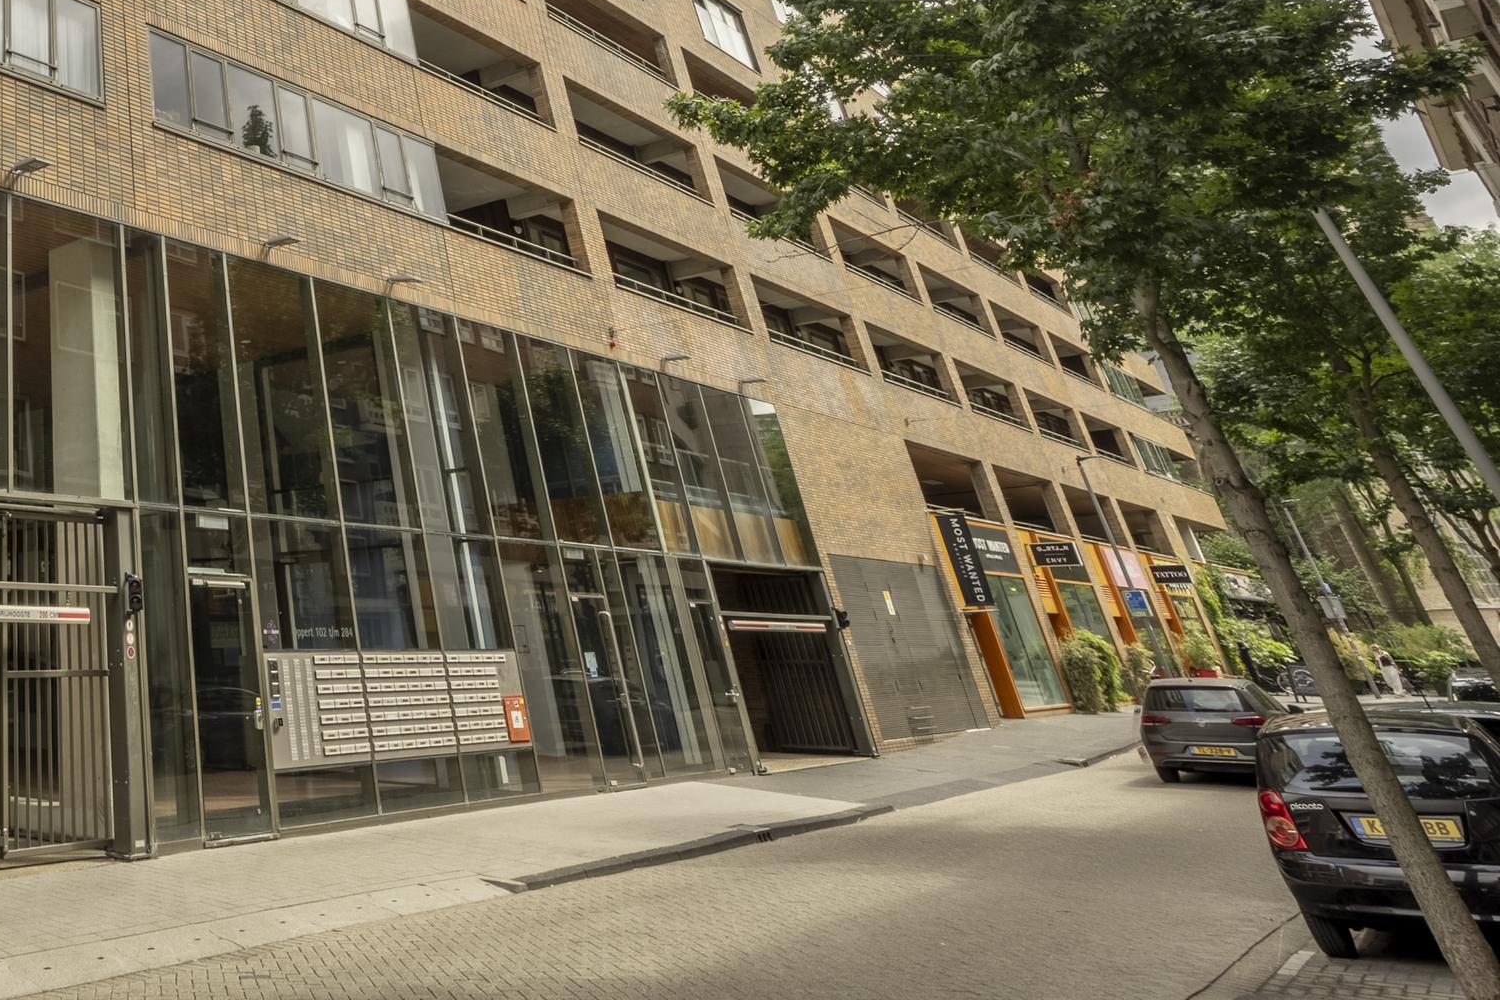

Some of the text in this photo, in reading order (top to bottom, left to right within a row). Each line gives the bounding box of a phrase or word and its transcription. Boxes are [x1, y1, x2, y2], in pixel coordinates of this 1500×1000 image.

[949, 518, 968, 550] MOST
[963, 554, 986, 602] WANTED
[316, 627, 327, 637] 102
[341, 627, 353, 637] 284
[1290, 802, 1324, 811] picanto
